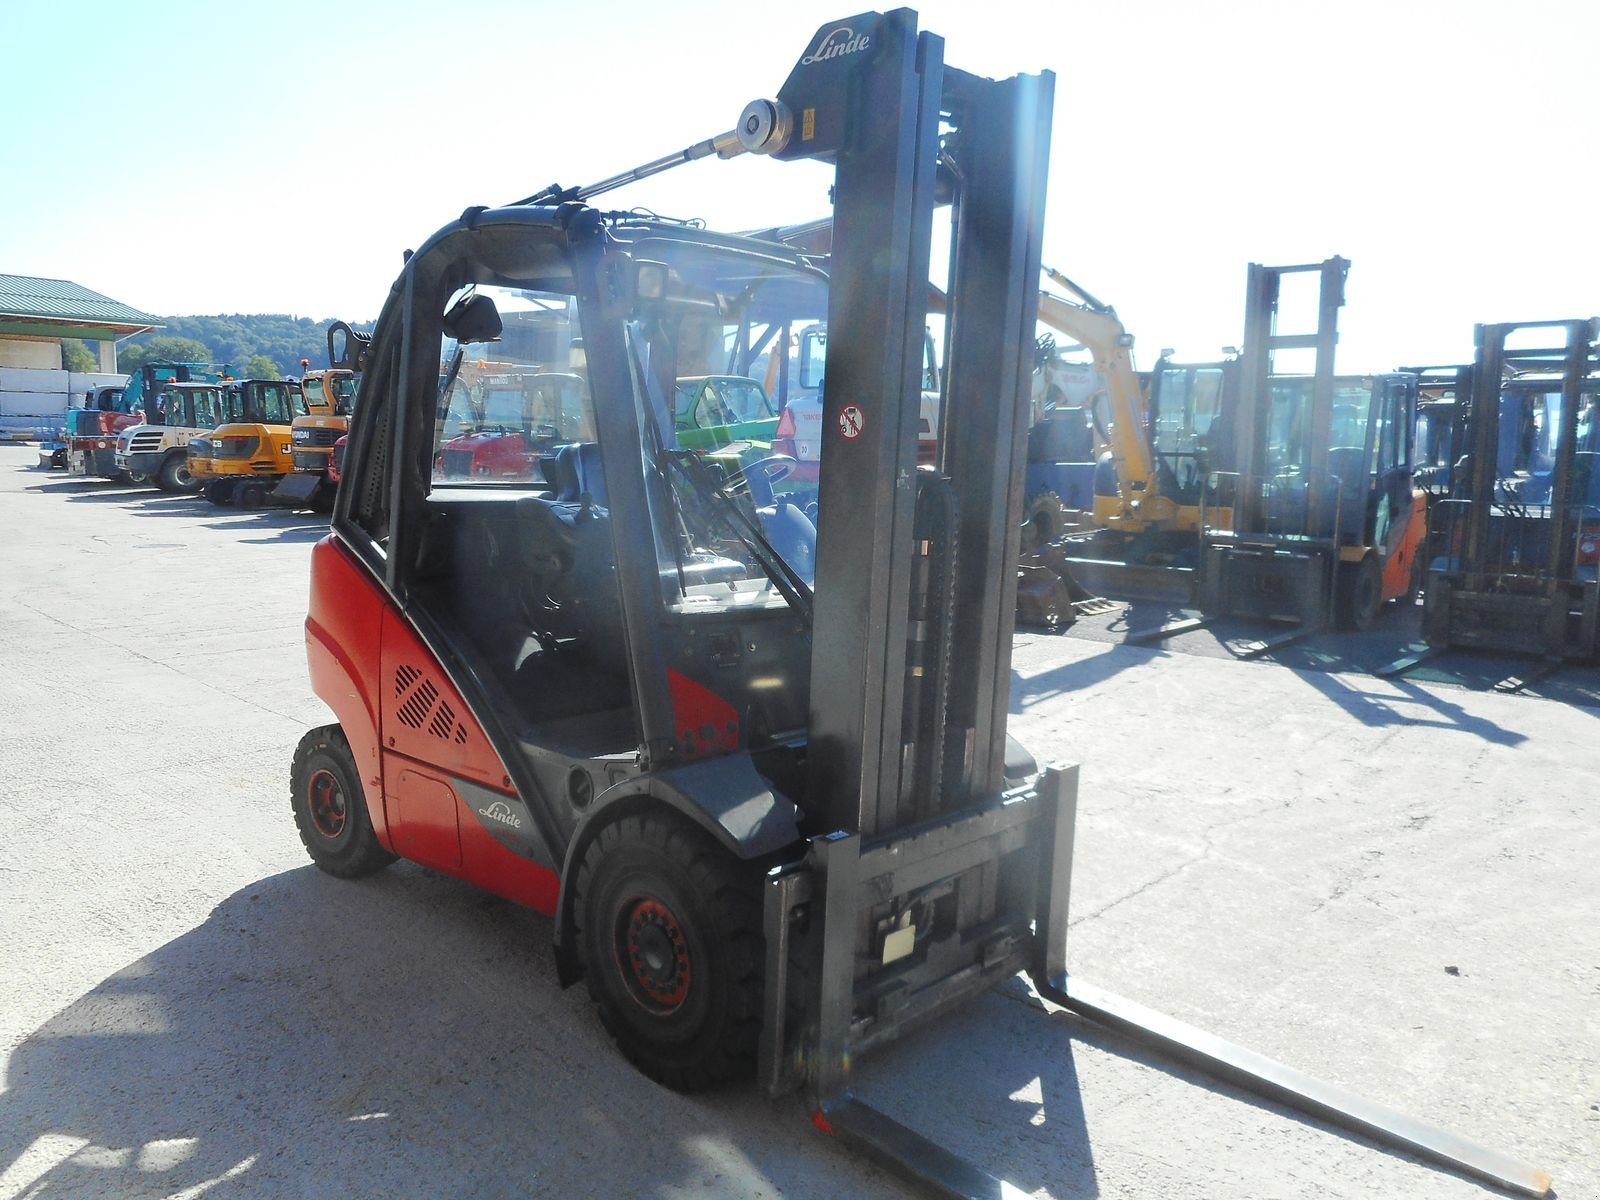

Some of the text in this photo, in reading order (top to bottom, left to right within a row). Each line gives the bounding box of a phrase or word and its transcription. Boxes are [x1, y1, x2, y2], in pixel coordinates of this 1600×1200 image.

[801, 27, 870, 65] Linde
[212, 440, 223, 448] CB
[478, 801, 521, 829] Linde
